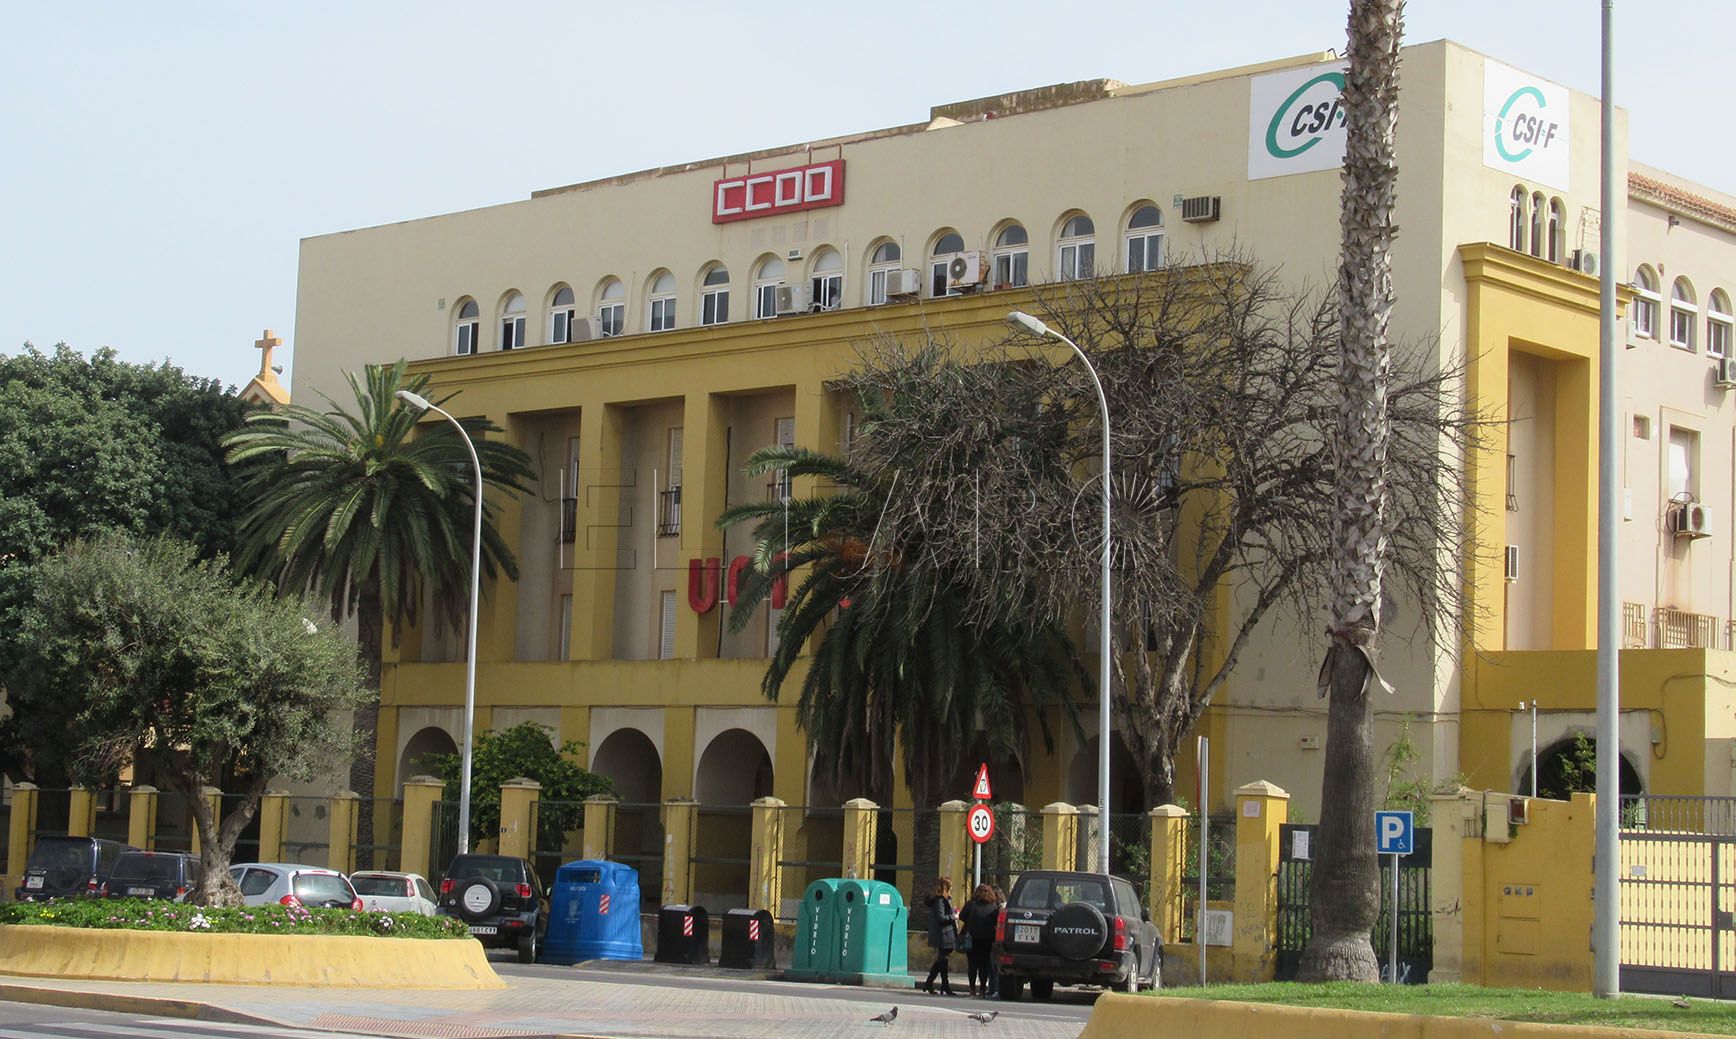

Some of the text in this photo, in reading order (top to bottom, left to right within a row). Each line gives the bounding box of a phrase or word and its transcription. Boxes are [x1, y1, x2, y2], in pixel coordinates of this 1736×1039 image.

[717, 166, 833, 216] CCOO
[974, 815, 988, 832] 30
[1382, 815, 1405, 849] P
[811, 906, 819, 955] VIDRIO
[842, 907, 852, 957] VIDRIO
[1054, 926, 1099, 935] PATROL
